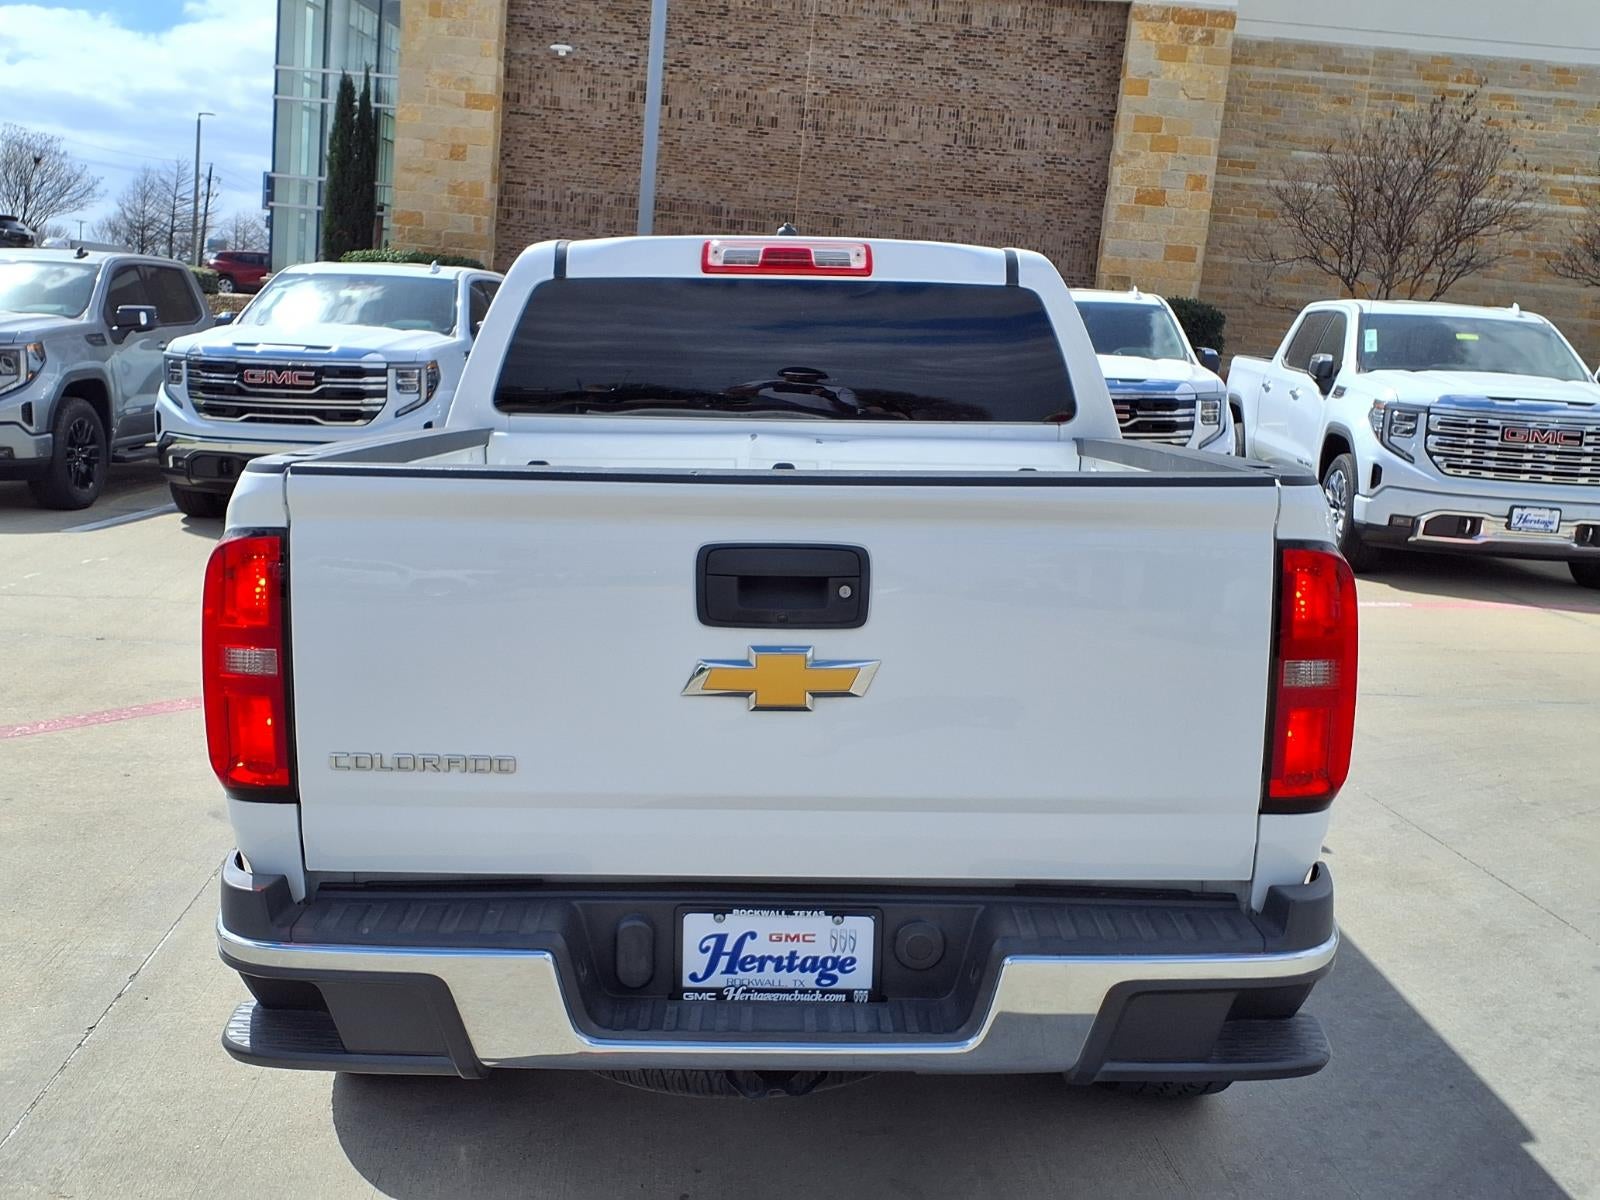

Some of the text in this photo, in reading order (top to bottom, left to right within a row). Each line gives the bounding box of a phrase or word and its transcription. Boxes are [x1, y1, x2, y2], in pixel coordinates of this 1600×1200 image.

[243, 369, 315, 385] GMC
[1504, 427, 1582, 446] GMC
[328, 752, 517, 774] COLORADO
[792, 910, 826, 918] TEXAS
[768, 933, 817, 943] GMC
[688, 930, 858, 987] Heritage
[792, 978, 806, 987] TX
[683, 992, 717, 1001] GMC
